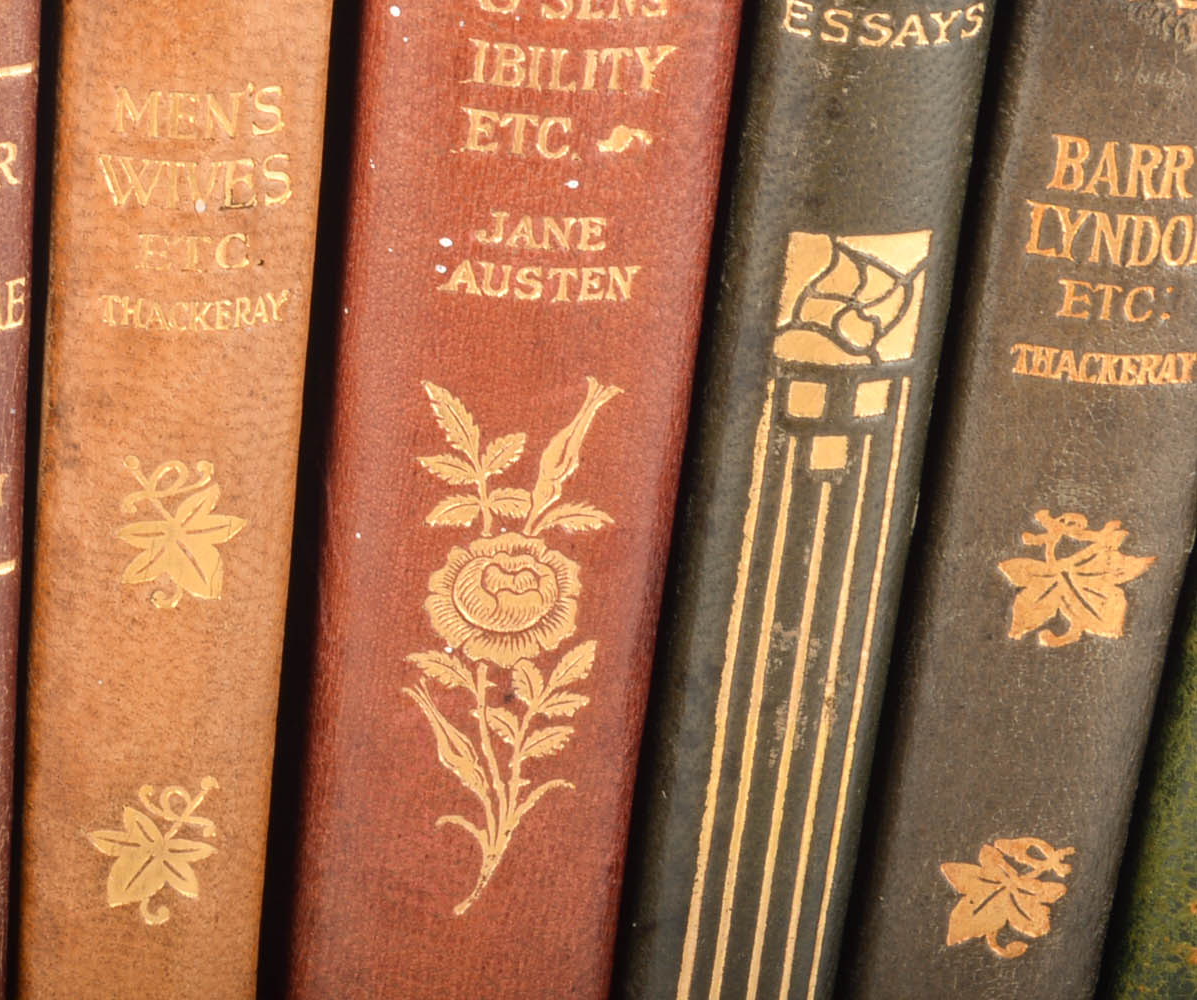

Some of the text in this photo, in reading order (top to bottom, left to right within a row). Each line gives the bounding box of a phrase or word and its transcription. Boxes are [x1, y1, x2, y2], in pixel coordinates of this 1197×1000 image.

[459, 38, 677, 93] IBILITY
[114, 82, 285, 140] MEN'S
[452, 106, 582, 161] ETC.
[98, 153, 292, 211] WIVES
[475, 208, 607, 251] JANE
[1025, 199, 1197, 268] LYNDO
[437, 259, 642, 303] AUSTEN
[98, 289, 290, 332] THACKERAY
[1010, 343, 1197, 386] THACKERAY
